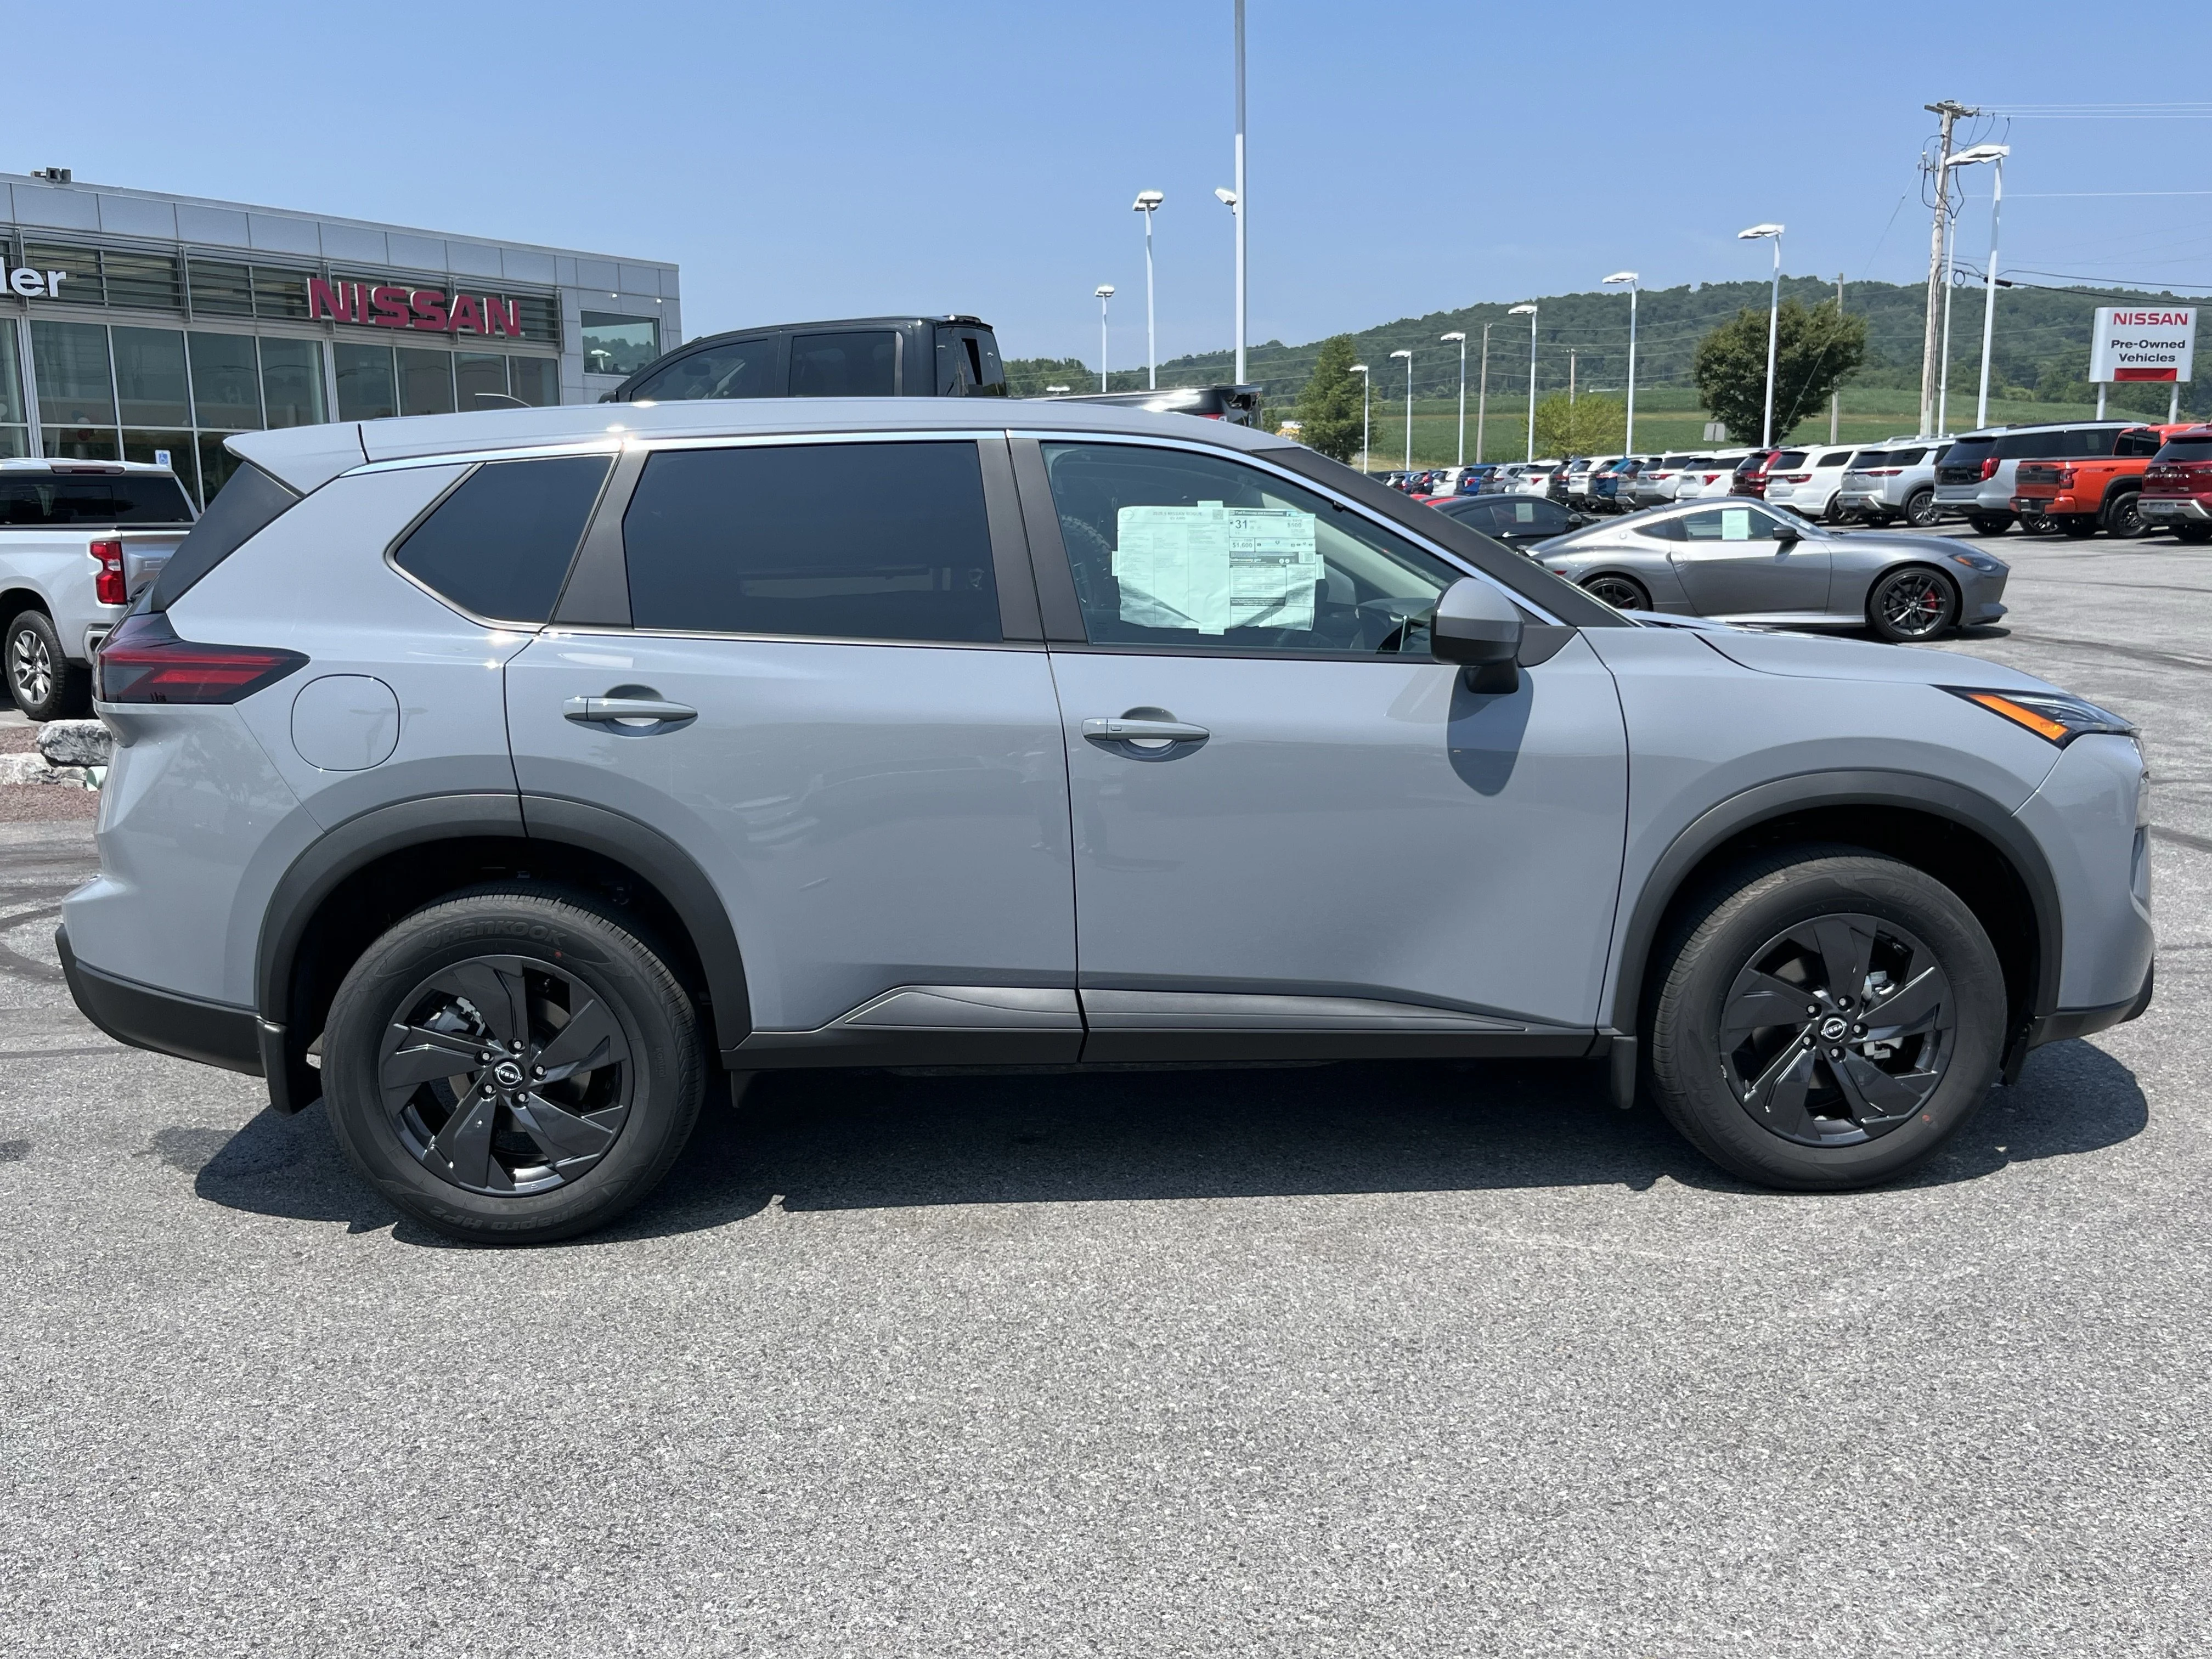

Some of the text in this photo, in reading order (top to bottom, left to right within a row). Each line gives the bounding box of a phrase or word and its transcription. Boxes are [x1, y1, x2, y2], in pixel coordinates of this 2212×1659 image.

[307, 278, 521, 337] NISSAN
[2113, 313, 2188, 325] NISSAN
[2111, 340, 2186, 349] Pre-Owned
[2119, 353, 2176, 362] Vehicles
[1235, 520, 1247, 529] 31
